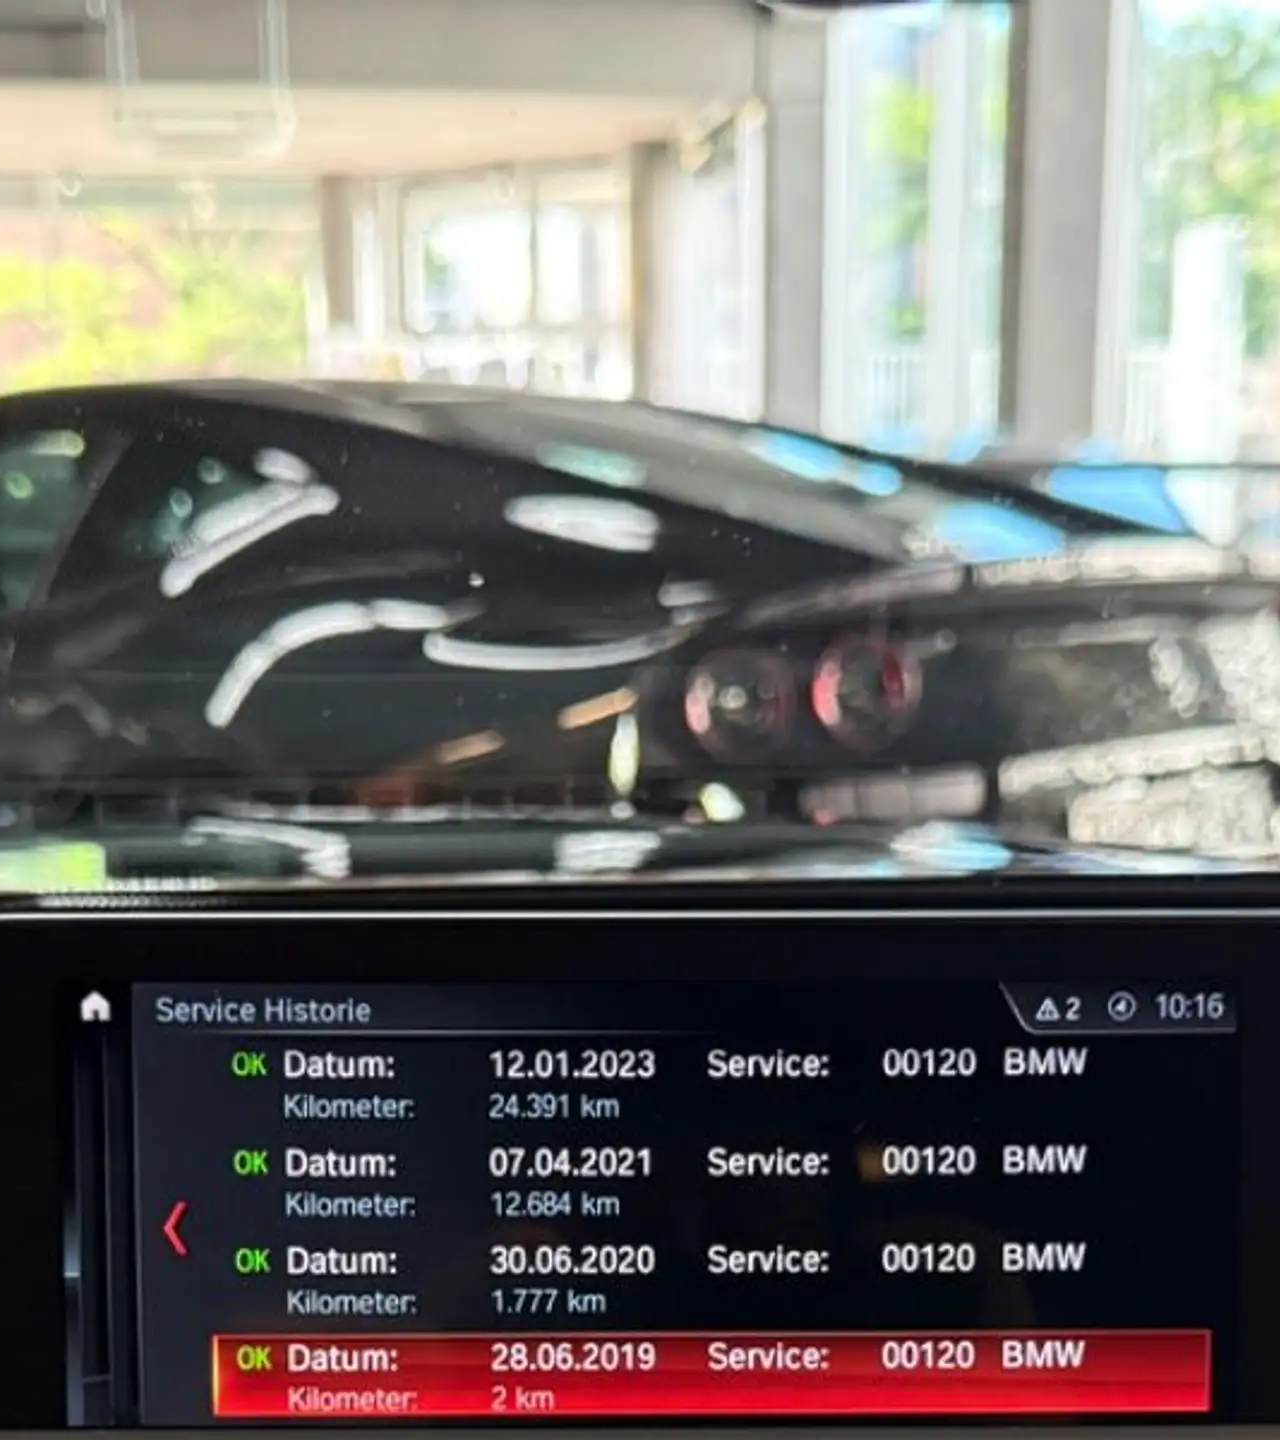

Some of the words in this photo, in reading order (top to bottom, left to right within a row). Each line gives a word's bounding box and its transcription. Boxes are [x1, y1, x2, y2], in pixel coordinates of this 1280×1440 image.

[155, 996, 255, 1023] Service
[264, 997, 372, 1024] Historie
[1065, 996, 1081, 1021] 2
[1156, 992, 1225, 1020] 10:16
[231, 1051, 267, 1077] OK
[283, 1049, 395, 1079] Datum:
[489, 1049, 656, 1079] 12.01.2023
[707, 1049, 830, 1078] Service:
[882, 1047, 977, 1077] 00120
[1003, 1047, 1088, 1076] BMW
[283, 1093, 414, 1119] Kilometer:
[488, 1092, 569, 1119] 24.391
[581, 1094, 620, 1119] km
[233, 1149, 268, 1175] OK
[285, 1147, 396, 1178] Datum:
[488, 1146, 651, 1178] 07.04.2021
[707, 1146, 829, 1177] Service:
[881, 1145, 977, 1176] 00120
[1002, 1144, 1087, 1174] BMW
[285, 1191, 416, 1218] Kilometer:
[491, 1190, 572, 1217] 12.684
[581, 1192, 620, 1216] km
[235, 1247, 270, 1273] OK
[287, 1245, 397, 1275] Datum:
[490, 1244, 656, 1275] 30.06.2020
[707, 1244, 829, 1274] Service:
[881, 1242, 976, 1273] 00120
[1002, 1242, 1086, 1272] BMW
[286, 1289, 416, 1315] Kilometer:
[491, 1288, 559, 1313] 1.777
[567, 1288, 606, 1313] km
[236, 1345, 272, 1371] OK
[287, 1343, 398, 1372] Datum:
[491, 1341, 656, 1372] 28.06.2019
[708, 1341, 829, 1371] Service:
[881, 1340, 976, 1370] 00120
[1002, 1340, 1086, 1369] BMW
[287, 1386, 418, 1412] Kilometer:
[491, 1384, 507, 1412] 2
[515, 1386, 555, 1412] km
